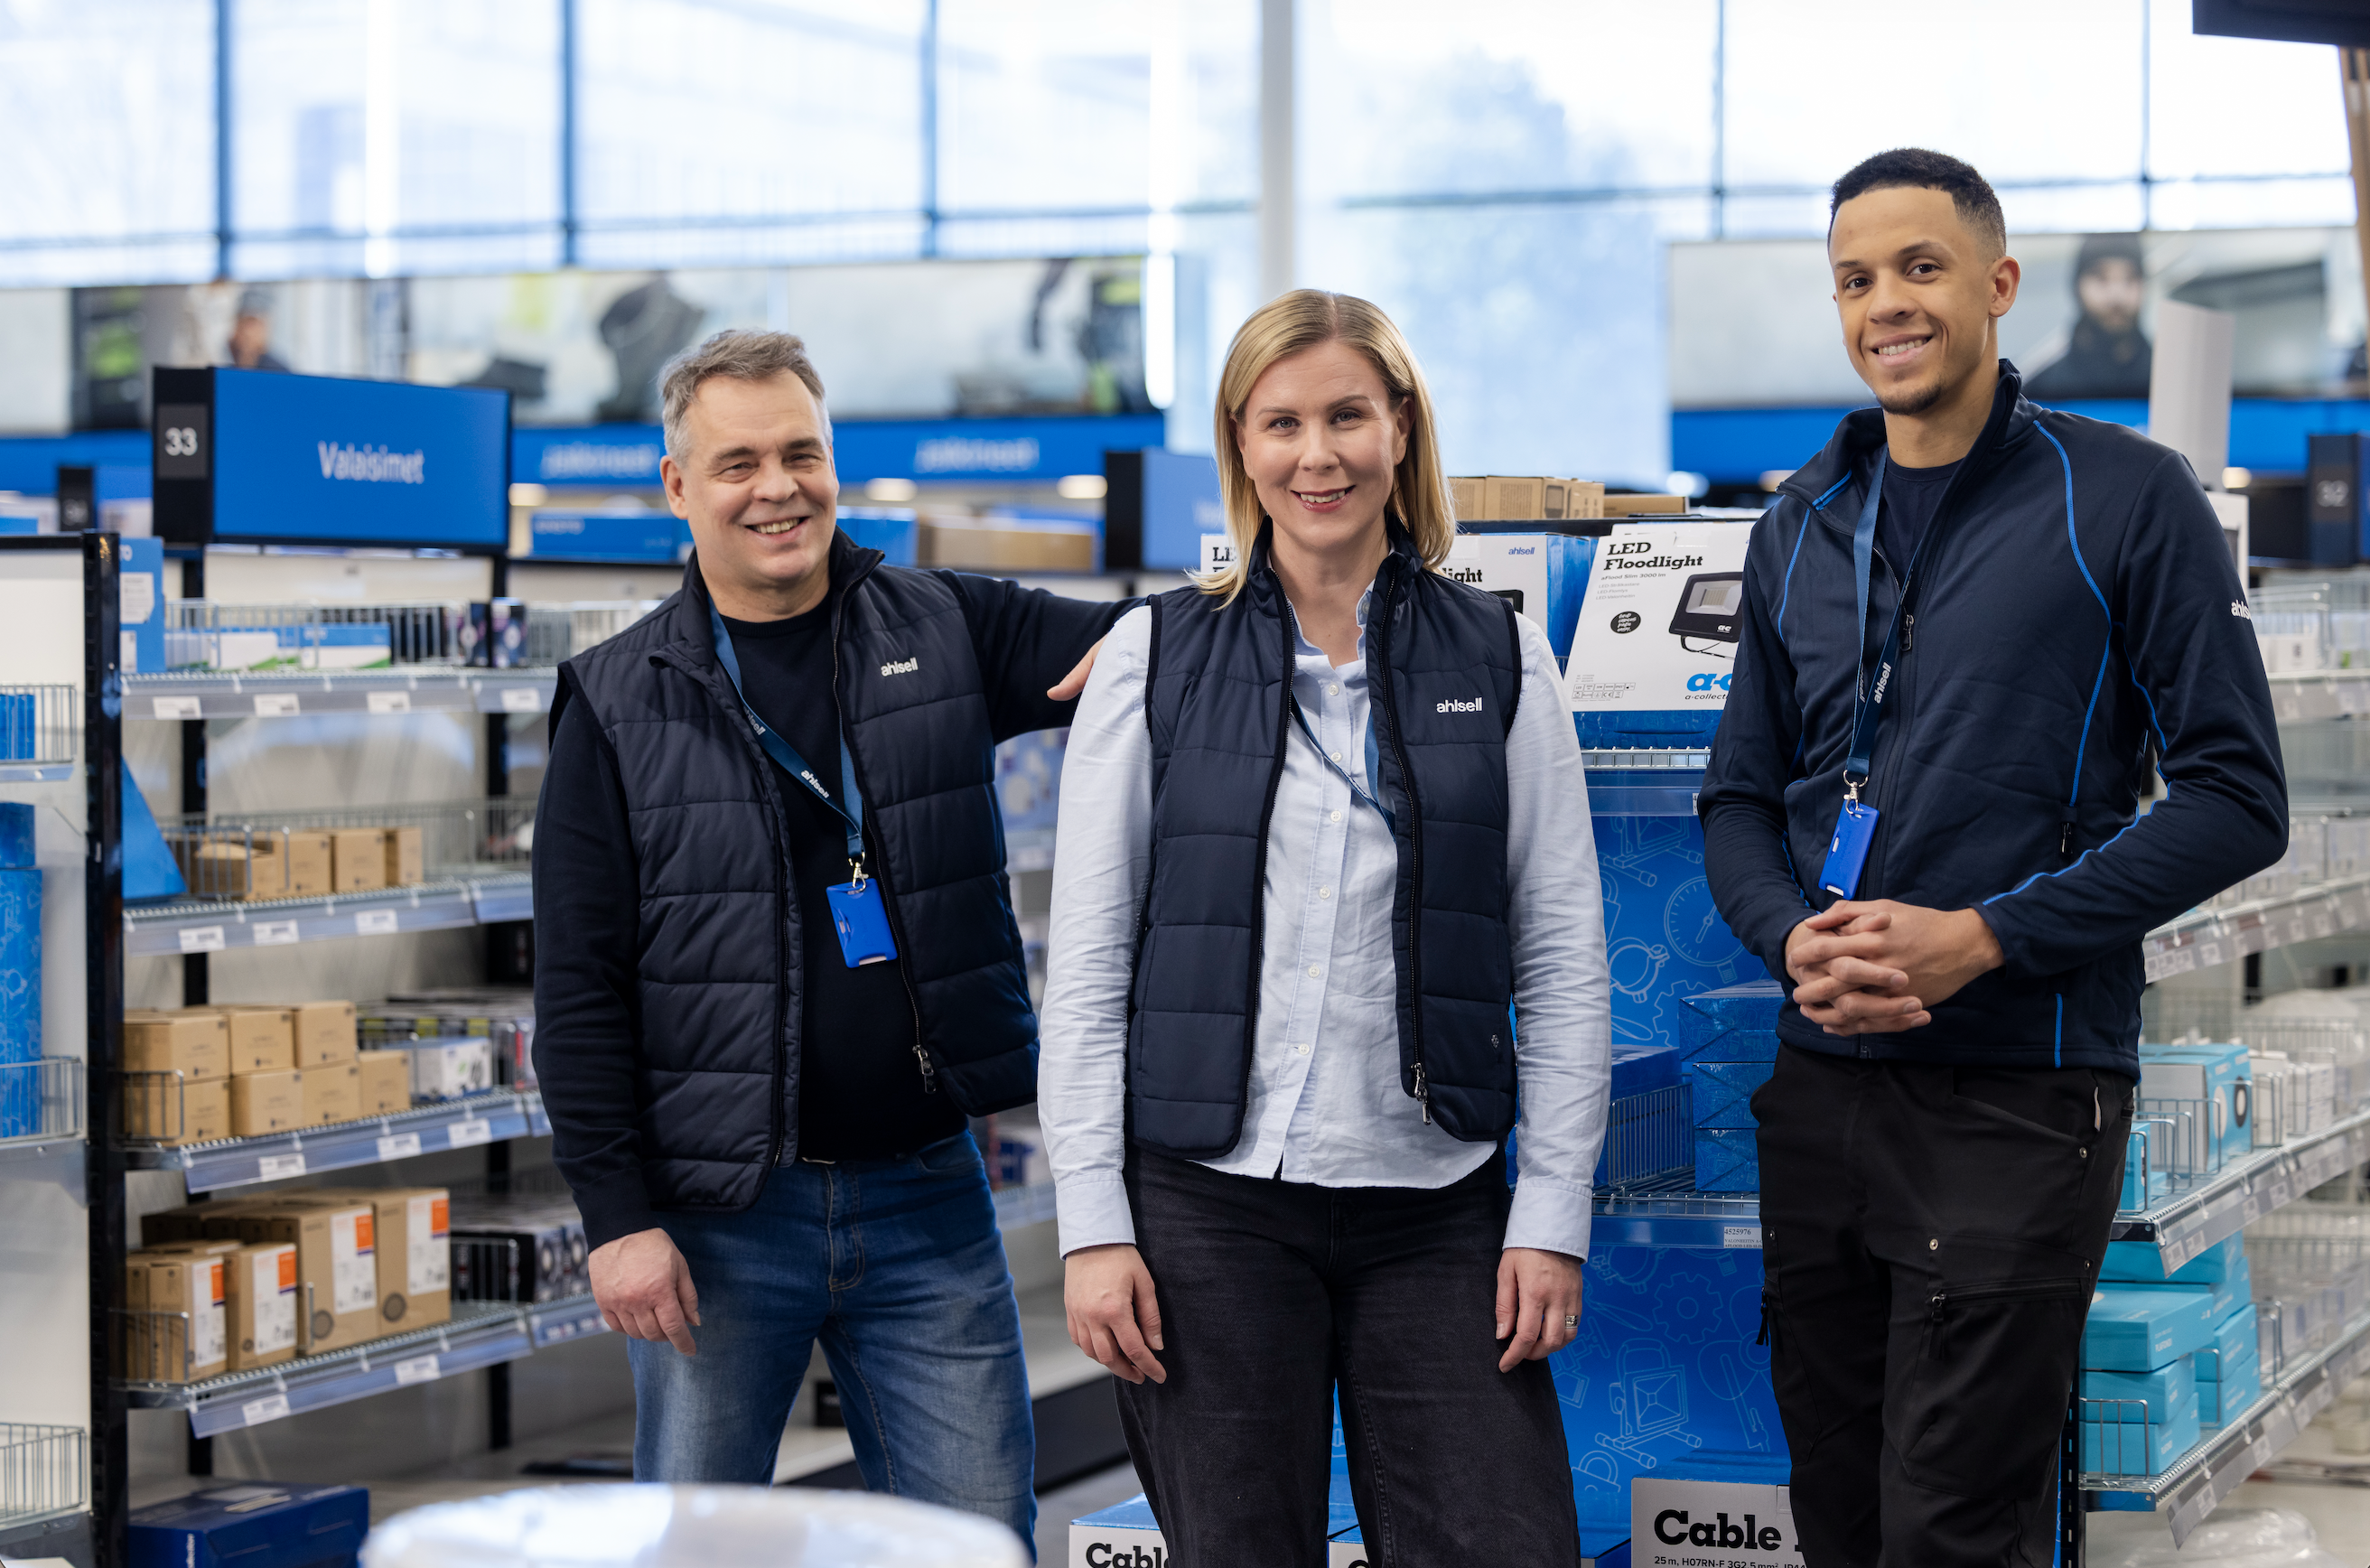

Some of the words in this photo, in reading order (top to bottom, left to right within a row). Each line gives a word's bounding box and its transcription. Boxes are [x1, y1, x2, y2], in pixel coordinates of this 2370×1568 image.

[164, 426, 198, 456] 33
[317, 440, 425, 485] Valaisimet
[1508, 546, 1535, 555] ahlsell
[1607, 542, 1651, 555] LED
[1603, 555, 1703, 571] Floodlight
[881, 657, 919, 677] ahlsell
[1874, 661, 1892, 704] ahlsell
[1436, 696, 1483, 714] ahlsell
[800, 770, 830, 799] ahlsell
[1654, 1508, 1782, 1551] Cable
[1086, 1542, 1170, 1568] Cabl
[1654, 1555, 1666, 1564] 25
[1682, 1557, 1725, 1568] H07RN-F
